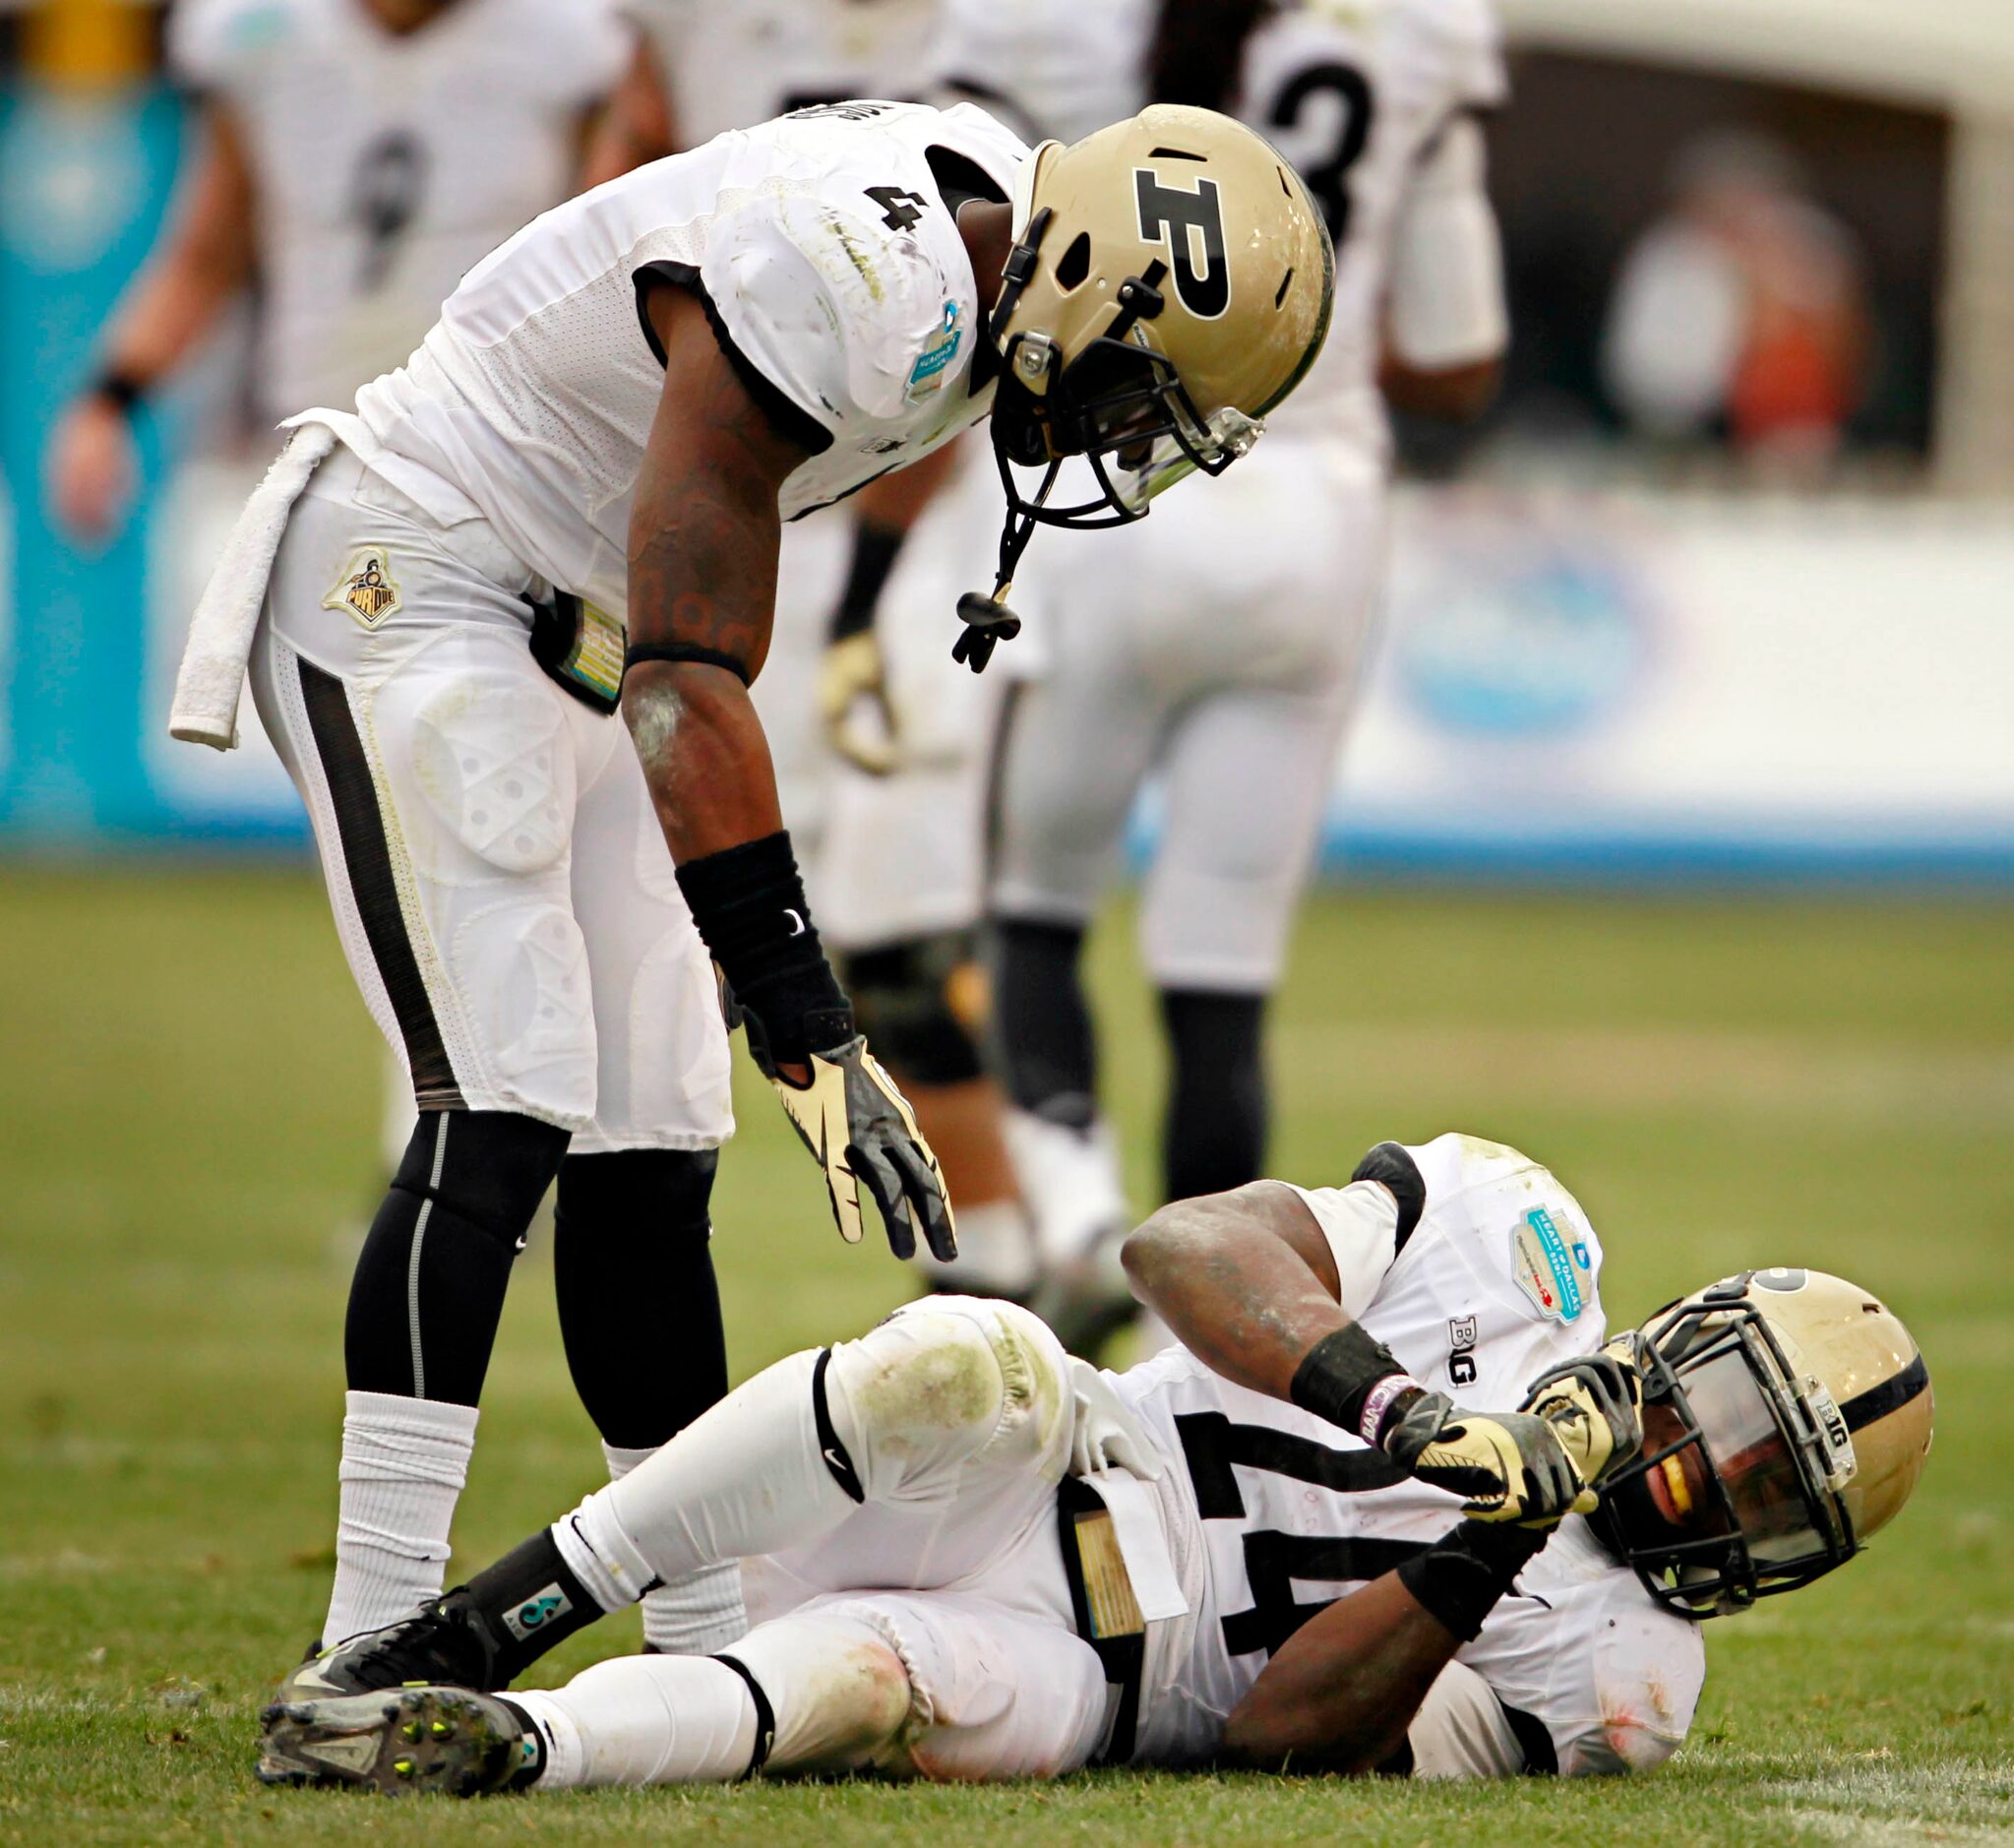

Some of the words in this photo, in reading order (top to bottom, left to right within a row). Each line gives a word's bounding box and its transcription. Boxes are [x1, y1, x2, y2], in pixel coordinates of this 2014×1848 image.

[863, 186, 930, 232] 4
[1132, 167, 1231, 321] P
[348, 588, 395, 616] PURDUE
[1539, 1212, 1564, 1253] HEART
[1562, 1264, 1581, 1311] DALLAS
